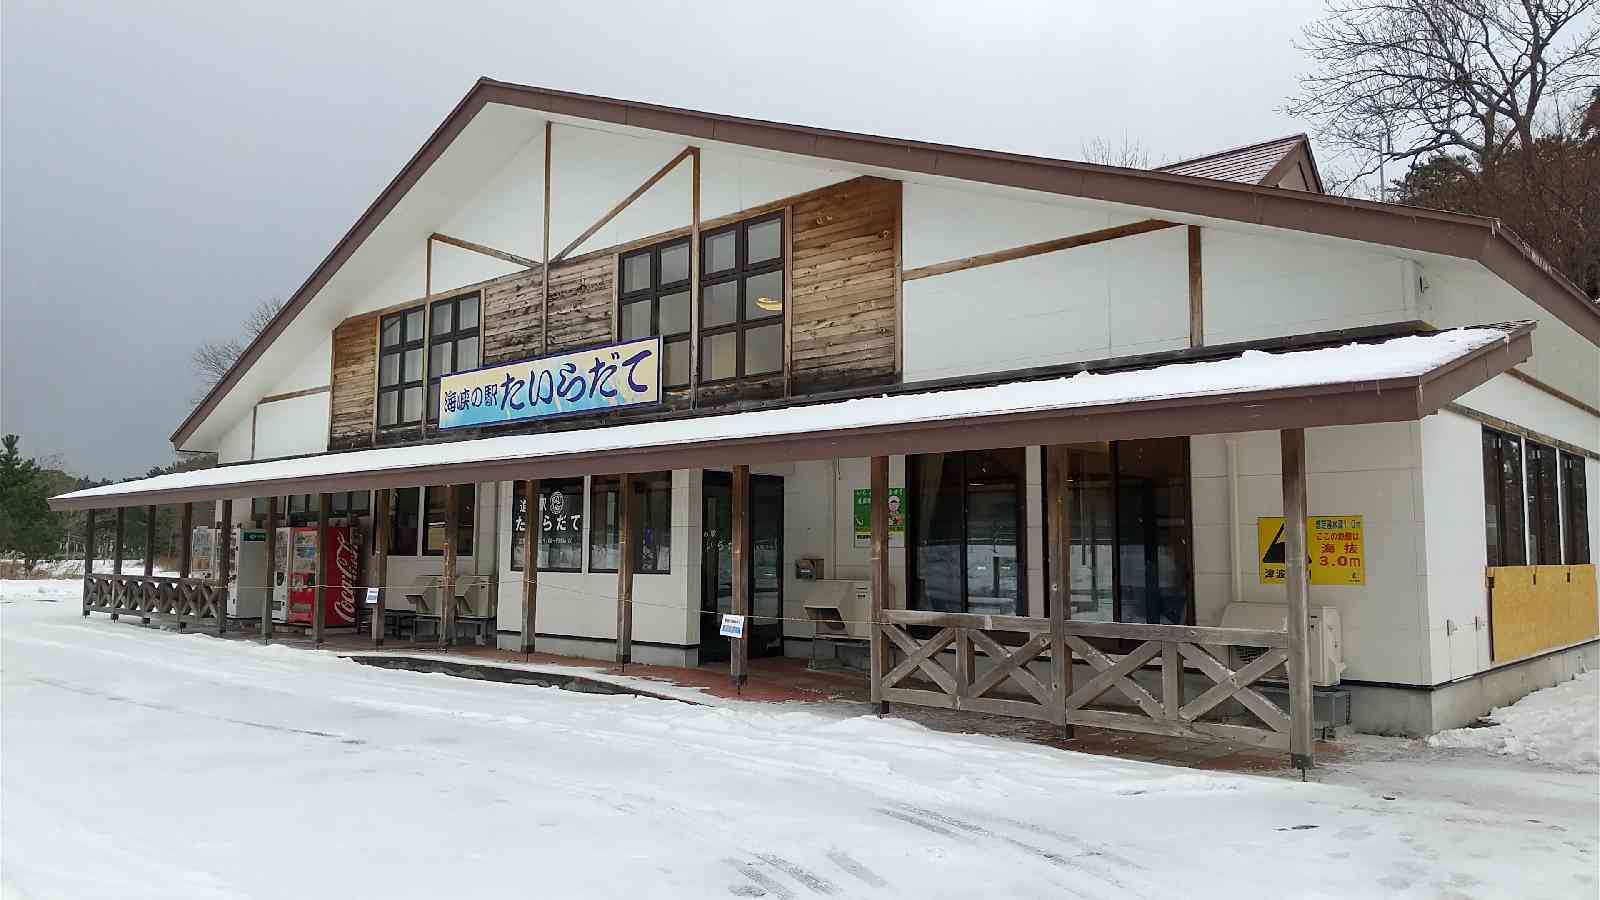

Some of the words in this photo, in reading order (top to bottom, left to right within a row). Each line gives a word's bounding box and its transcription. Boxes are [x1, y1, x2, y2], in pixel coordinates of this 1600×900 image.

[444, 383, 499, 413] 海峡の駅
[500, 349, 653, 411] たいらだて
[515, 514, 581, 532] たらだて
[1319, 555, 1361, 567] 3.0m
